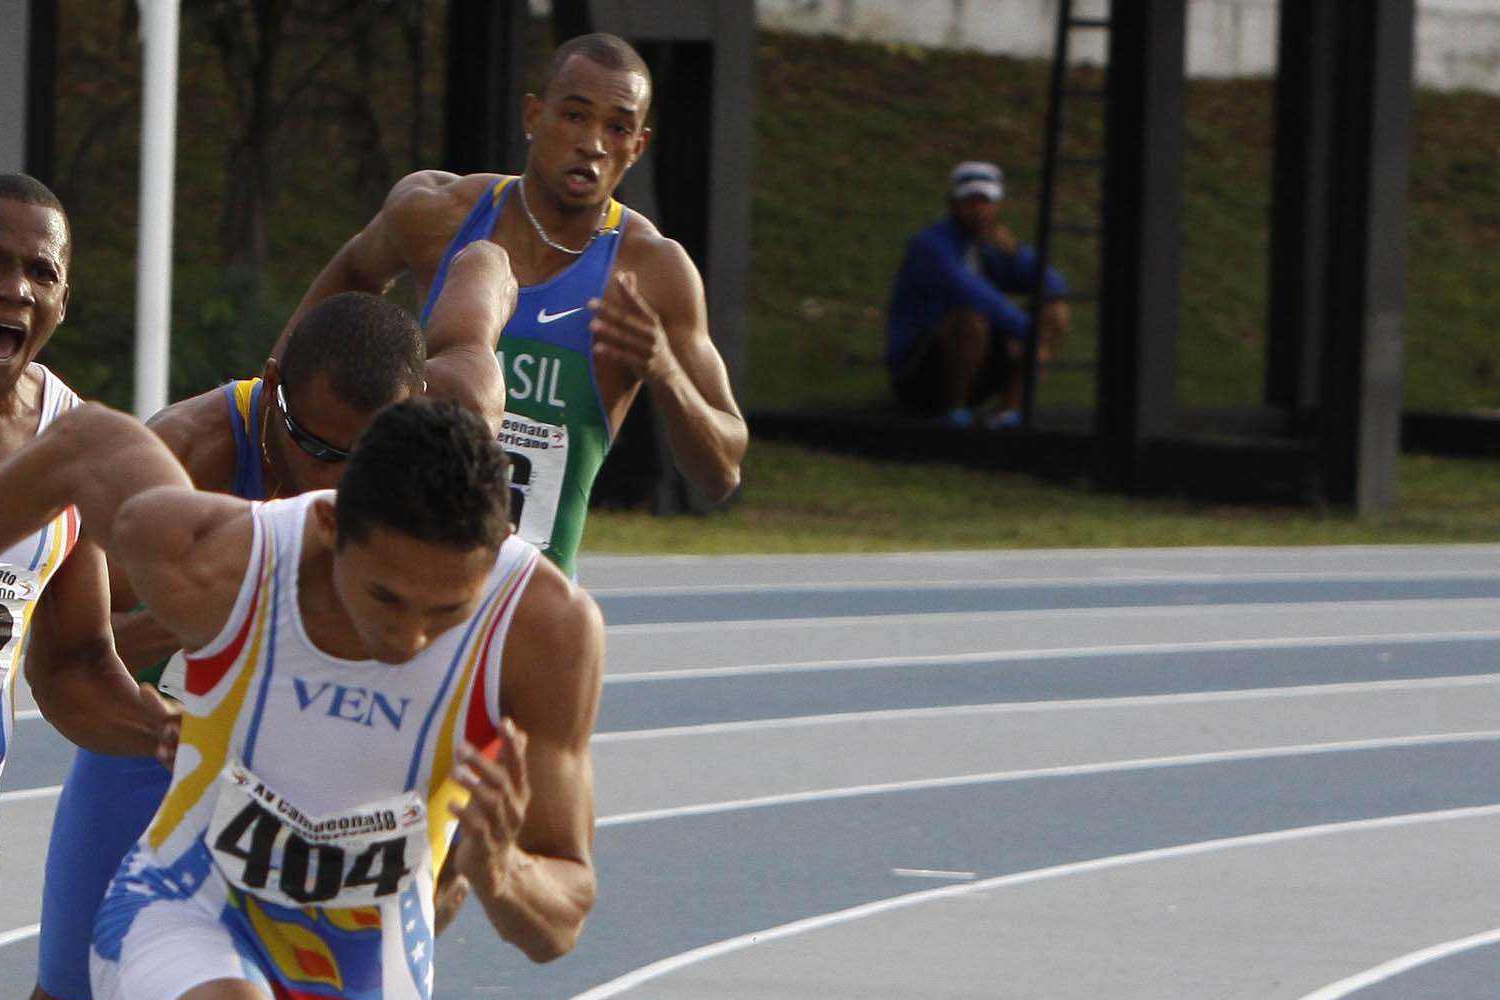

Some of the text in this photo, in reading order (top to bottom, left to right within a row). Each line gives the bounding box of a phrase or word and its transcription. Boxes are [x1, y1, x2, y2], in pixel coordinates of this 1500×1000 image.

[497, 350, 567, 408] SIL
[499, 432, 549, 450] ericano
[503, 419, 549, 438] eonato
[292, 677, 411, 731] VEN
[215, 799, 411, 904] 404
